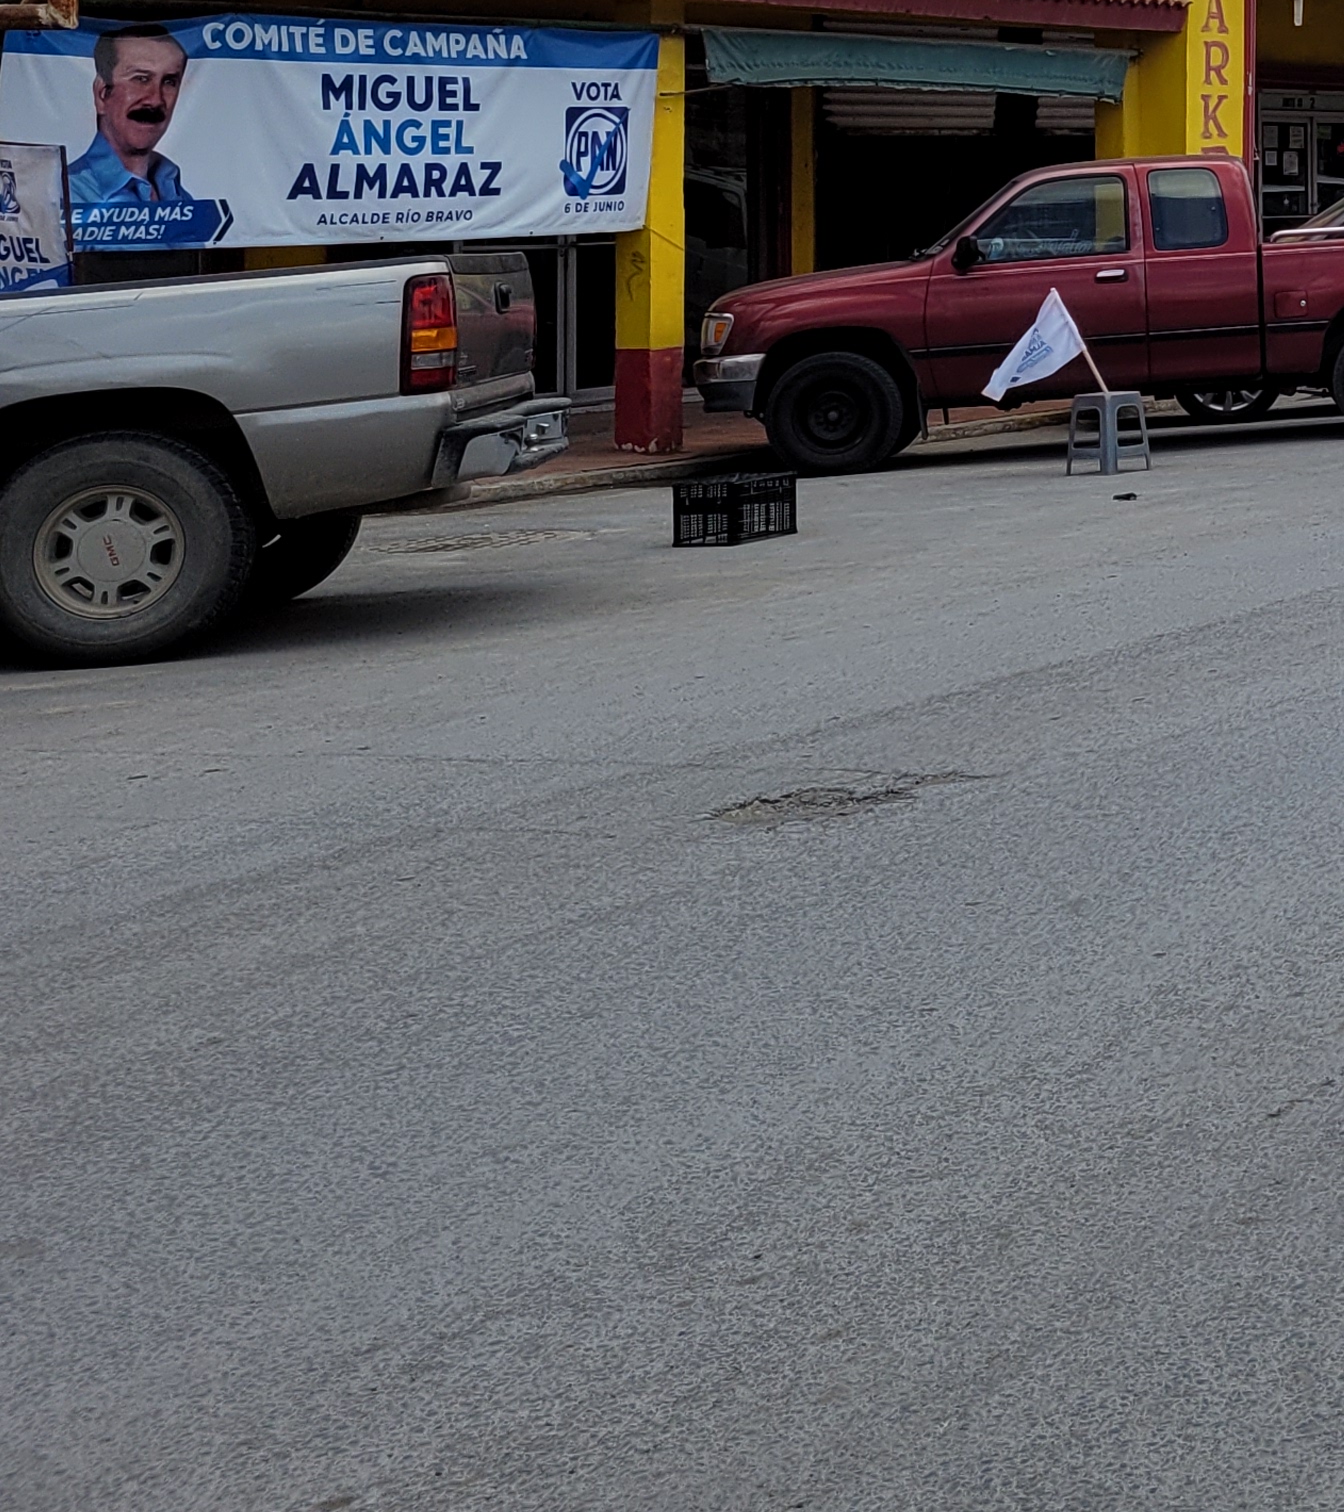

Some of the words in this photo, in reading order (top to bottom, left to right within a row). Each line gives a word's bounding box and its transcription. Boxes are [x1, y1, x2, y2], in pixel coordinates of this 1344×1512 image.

[202, 19, 326, 55] COMITÉ
[334, 28, 376, 55] DE
[383, 28, 528, 59] CAMPAÑA
[321, 73, 480, 112] MIGUEL
[571, 81, 622, 101] VOTA
[329, 112, 474, 156] ÁNGEL
[575, 131, 618, 172] PAN
[286, 161, 503, 201] ALMARAZ
[88, 207, 150, 224] AYUDA
[154, 202, 194, 222] MÁS
[317, 210, 391, 226] ALCALDE
[395, 208, 421, 224] RÍO
[425, 209, 474, 223] BRAVO
[564, 203, 571, 214] 6
[575, 202, 589, 213] DE
[593, 200, 625, 212] JUNIO
[118, 220, 166, 241] MÁS!
[103, 534, 119, 566] GMC
